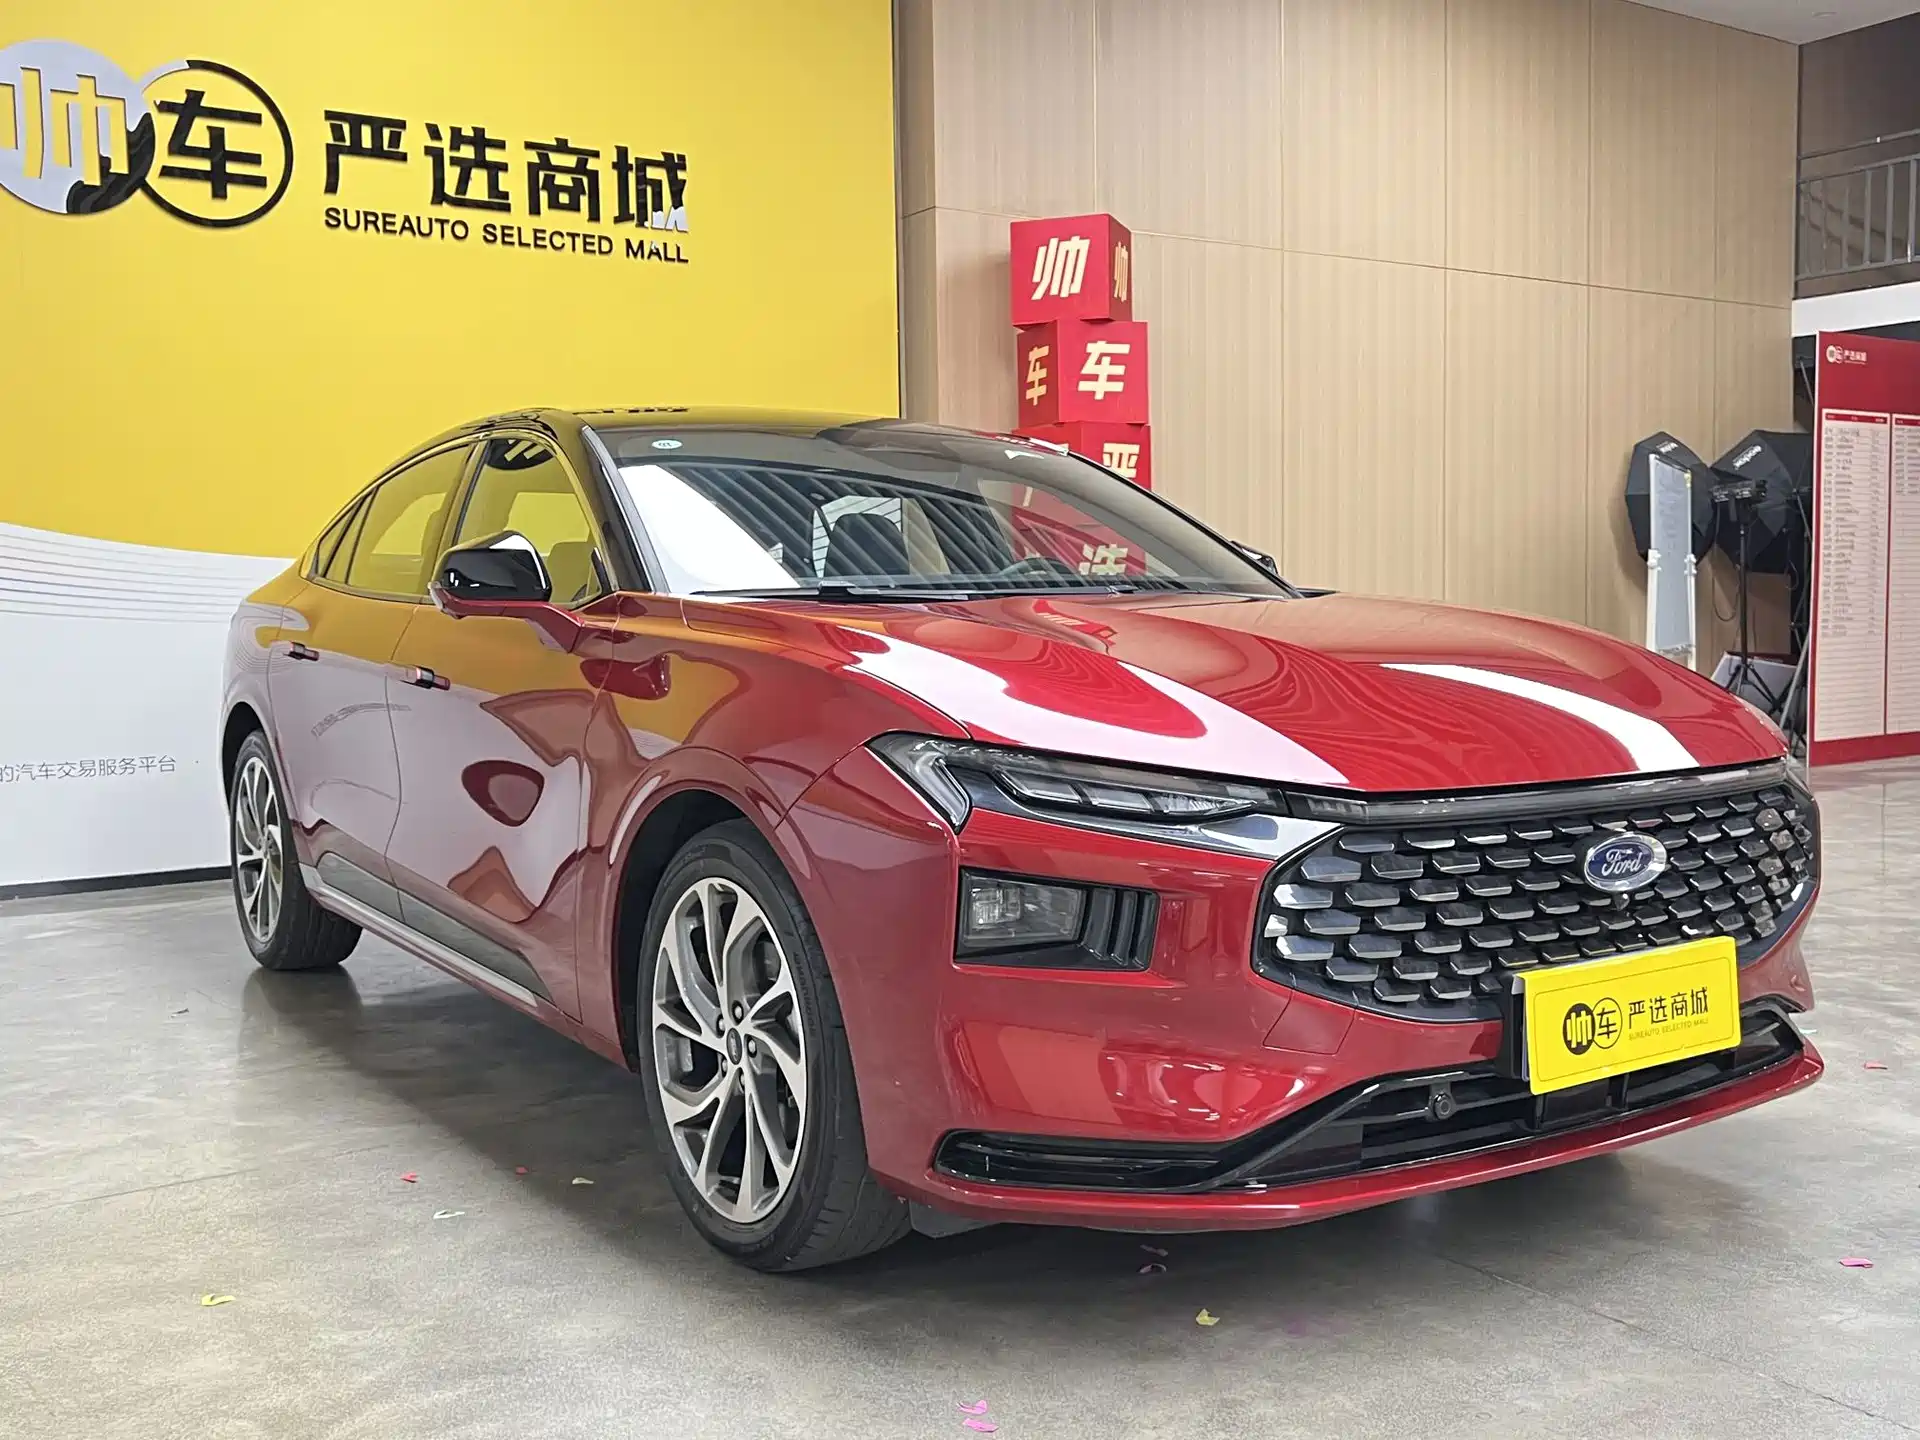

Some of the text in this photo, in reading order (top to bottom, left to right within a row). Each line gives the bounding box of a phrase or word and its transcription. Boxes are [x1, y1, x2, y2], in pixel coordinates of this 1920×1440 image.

[324, 110, 688, 232] 严选商城
[324, 207, 689, 264] SUREAUTO SELECTED MALL
[1031, 235, 1091, 301] 帅
[1114, 241, 1128, 302] 帅
[1025, 346, 1050, 406] 车
[1078, 340, 1131, 400] 车
[0, 754, 176, 783] 的汽车交易服务平台
[1601, 848, 1643, 876] Ford
[1566, 986, 1709, 1049] 帅车 严选商城
